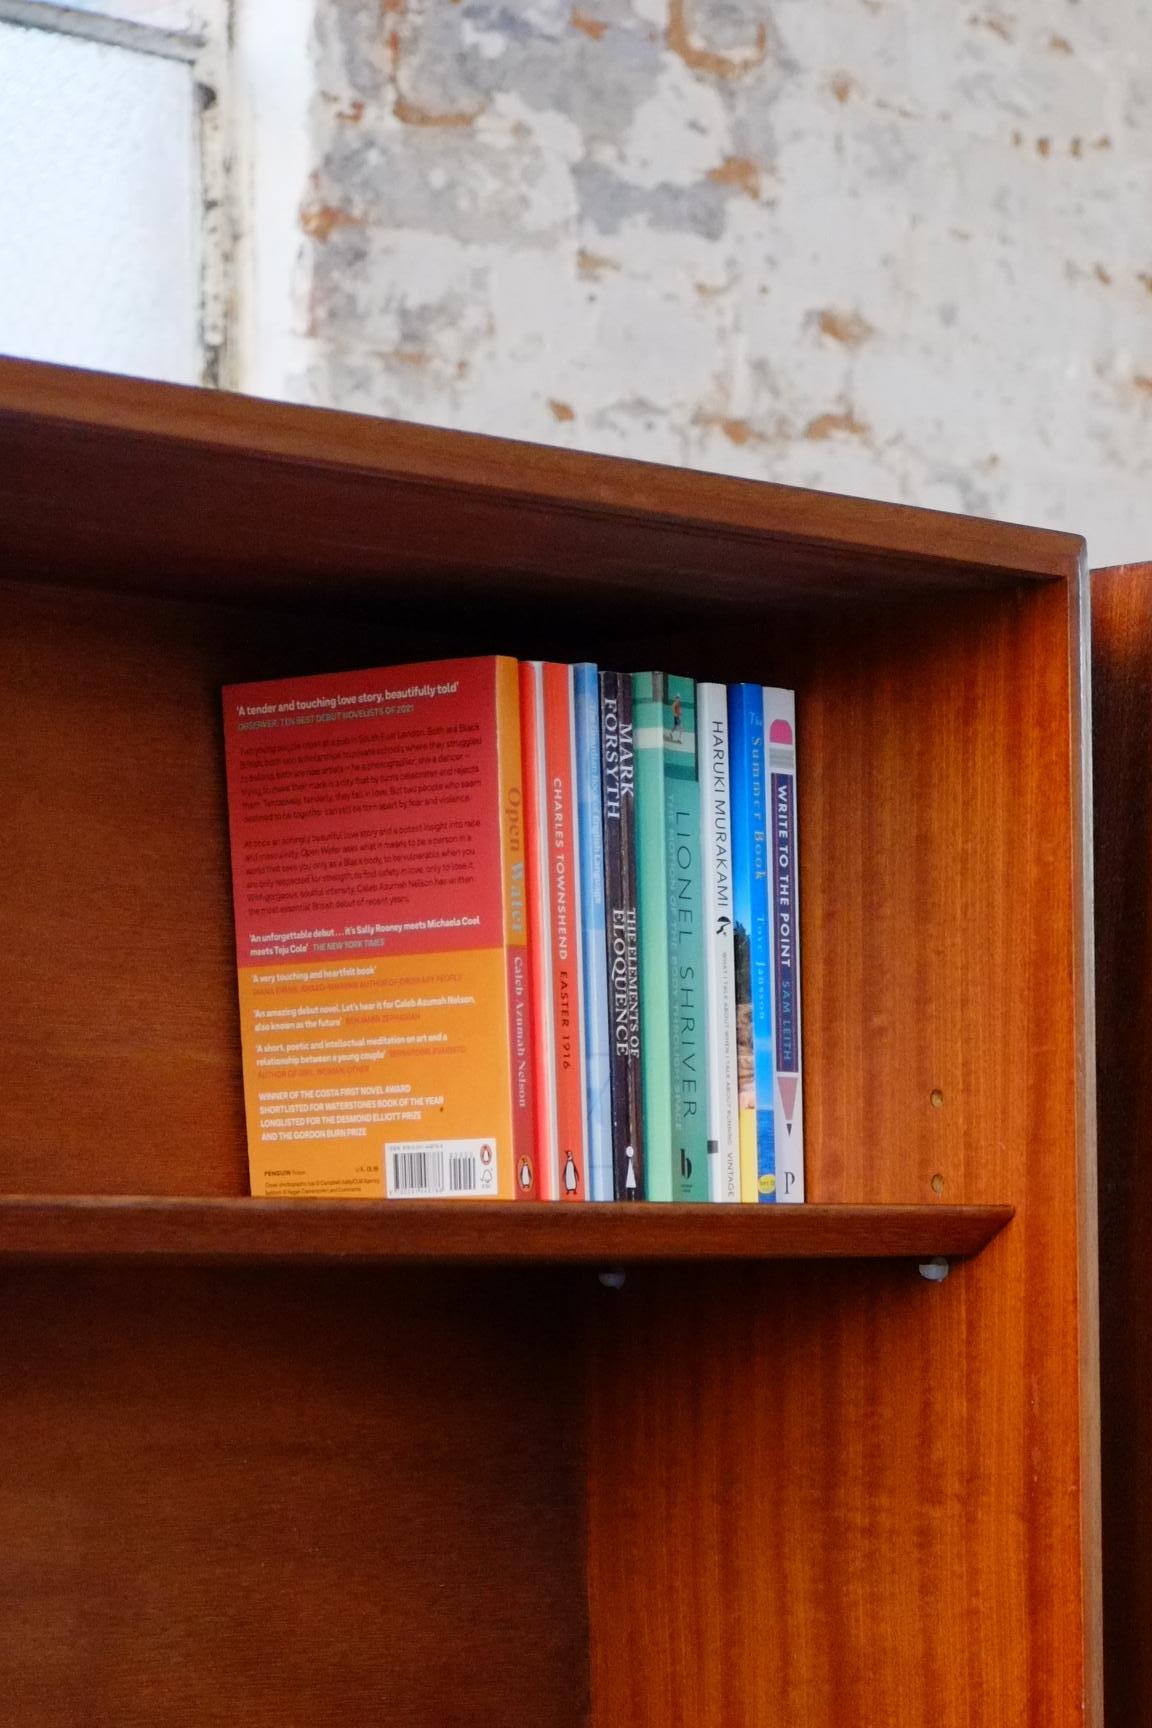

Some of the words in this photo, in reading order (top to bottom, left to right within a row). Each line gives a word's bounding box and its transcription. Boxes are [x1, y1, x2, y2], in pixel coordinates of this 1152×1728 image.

[247, 702, 276, 715] tender
[278, 700, 294, 712] and
[296, 695, 336, 713] touching
[337, 693, 356, 705] love
[384, 684, 437, 703] beautifully
[604, 697, 620, 820] FORSYTH
[619, 722, 634, 800] MARK
[712, 721, 724, 793] HARUKI
[751, 736, 762, 821] Summer
[505, 787, 522, 852] Open
[553, 778, 564, 848] CHARLES
[778, 786, 788, 838] WRITE
[676, 812, 692, 944] LIONEL
[714, 800, 728, 906] MURAKAMI
[754, 831, 766, 880] Book
[779, 845, 789, 868] TO
[511, 860, 524, 933] Water
[556, 854, 567, 960] TOWNSHEND
[779, 875, 790, 906] THE
[627, 907, 637, 943] THE
[756, 916, 765, 953] Tove
[780, 912, 791, 968] POINT
[514, 956, 523, 995] Caleb
[560, 971, 570, 1027] EASTER
[611, 909, 629, 1057] ELOQUENCE
[628, 946, 638, 1032] ELEMENTS
[754, 962, 766, 1020] Jansson
[782, 980, 792, 1013] SAM
[515, 1000, 525, 1056] Azumah
[562, 1035, 571, 1070] 1916
[630, 1035, 639, 1059] OF
[680, 966, 697, 1118] SHRIVER
[783, 1020, 792, 1060] LEITH
[518, 1060, 528, 1108] Nelson
